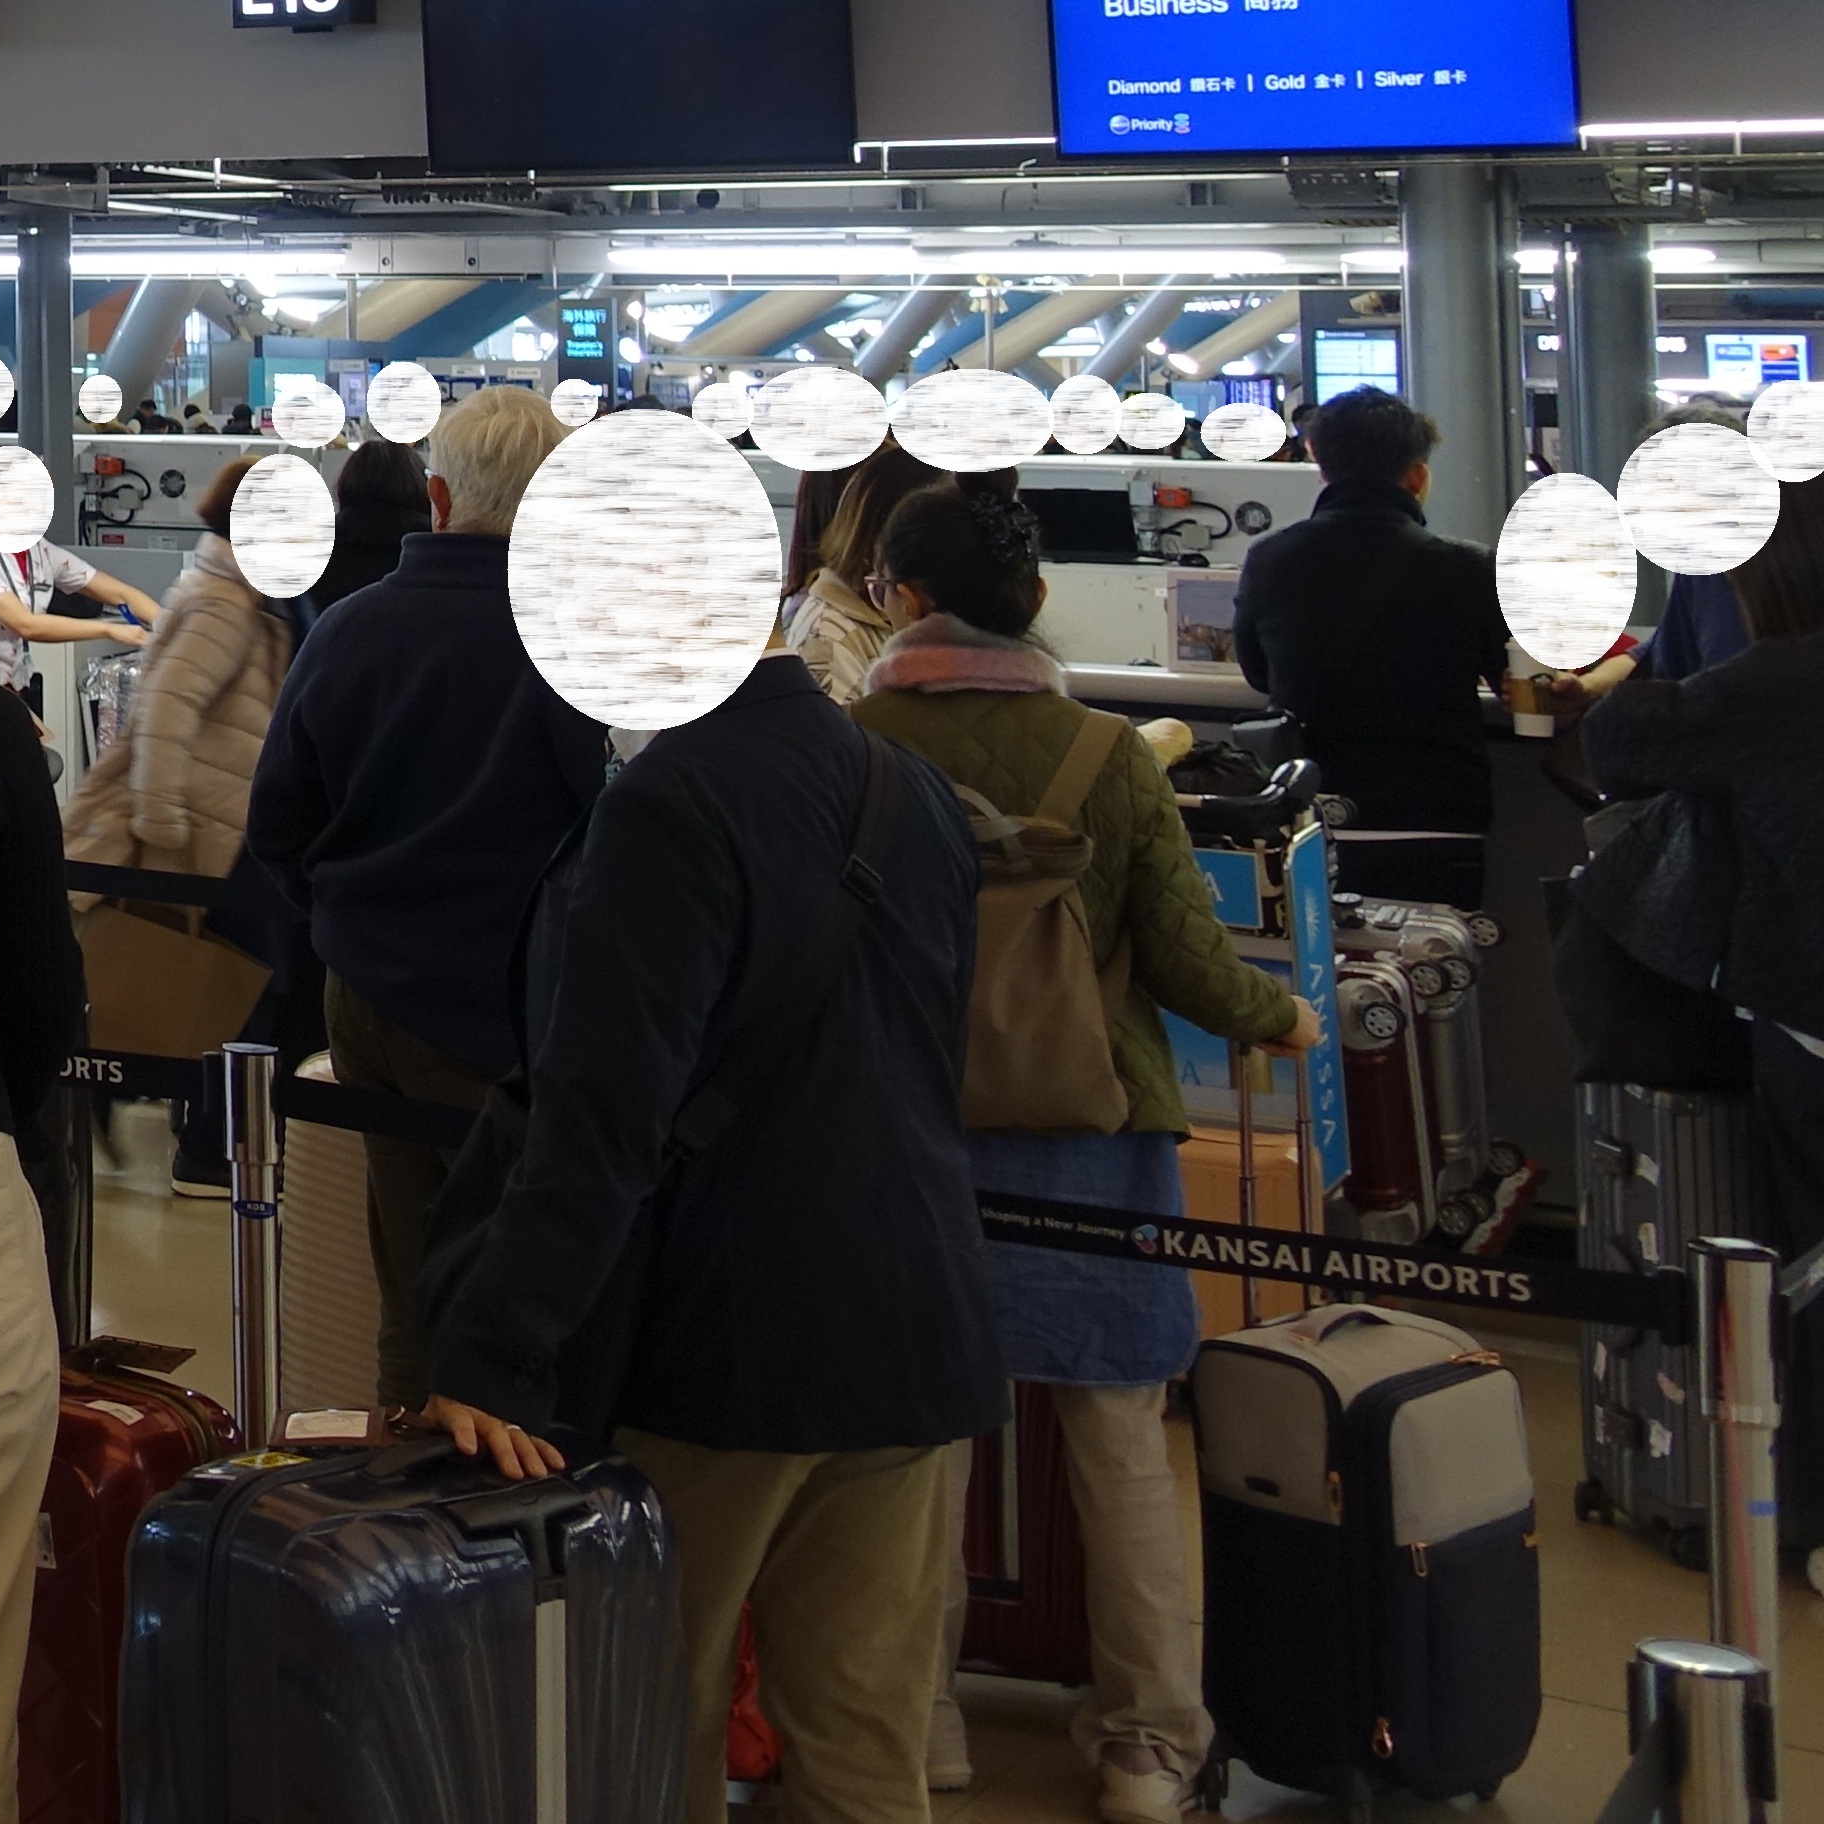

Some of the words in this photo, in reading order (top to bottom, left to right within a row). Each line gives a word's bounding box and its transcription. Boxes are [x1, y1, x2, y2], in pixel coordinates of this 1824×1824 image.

[1107, 79, 1181, 95] Diamond
[1264, 73, 1305, 90] Gold
[1313, 73, 1346, 89] 金卡
[1374, 69, 1424, 87] Silver
[1131, 117, 1173, 132] Priority
[981, 1207, 1031, 1226] Shaping
[1033, 1217, 1041, 1226] a
[1044, 1216, 1073, 1230] New
[1077, 1221, 1125, 1241] Journey
[1163, 1229, 1310, 1274] KANSAI
[1322, 1250, 1532, 1302] AIRPORTS
